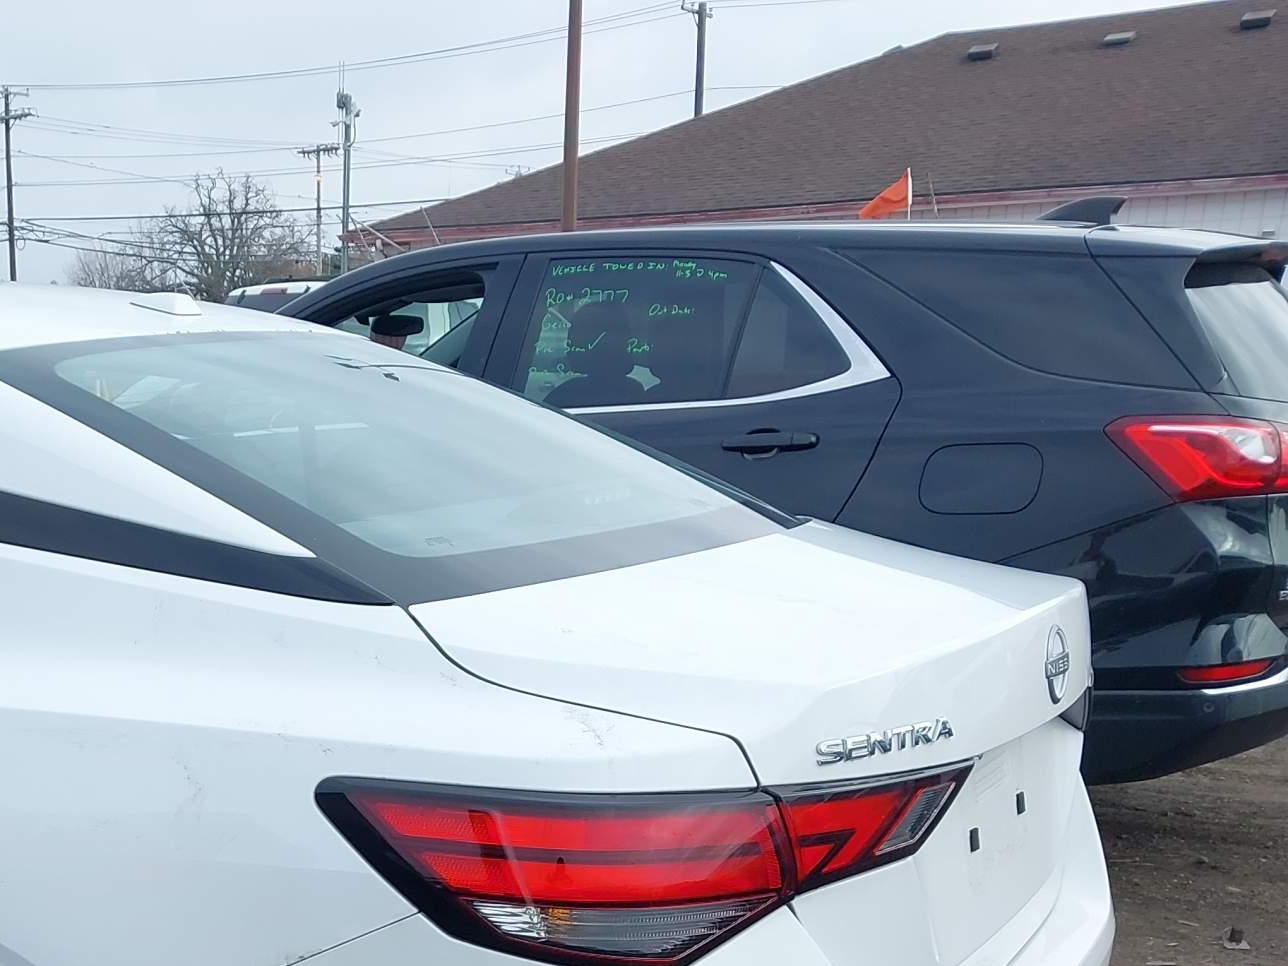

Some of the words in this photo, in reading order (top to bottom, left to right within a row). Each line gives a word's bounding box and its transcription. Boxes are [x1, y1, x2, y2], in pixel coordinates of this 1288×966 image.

[552, 263, 596, 276] VEHICLE
[603, 262, 643, 272] TOWED
[578, 287, 630, 305] 2777
[815, 716, 955, 766] SENTRA
